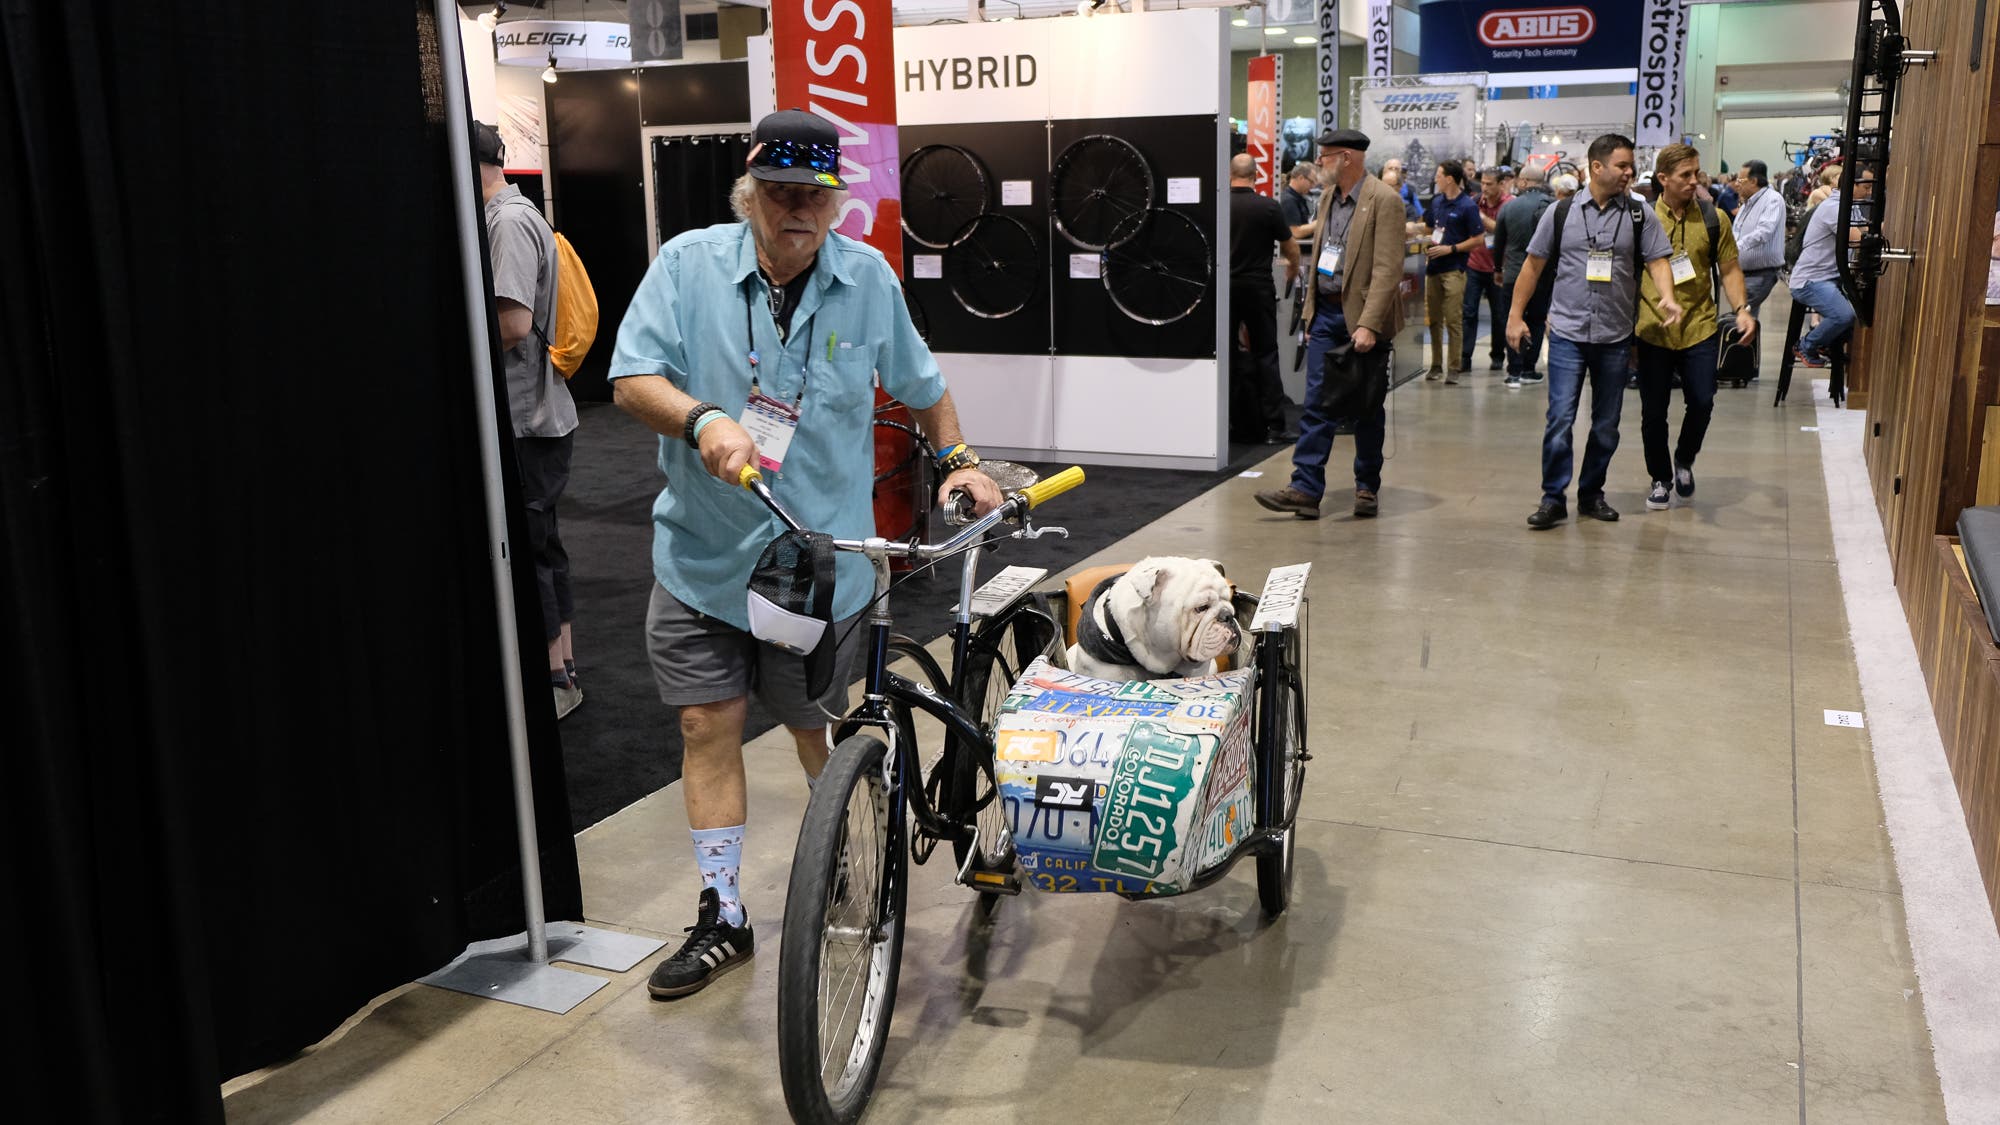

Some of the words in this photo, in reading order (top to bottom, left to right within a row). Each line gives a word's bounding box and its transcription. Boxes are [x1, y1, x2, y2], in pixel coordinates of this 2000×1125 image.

[1493, 15, 1580, 39] ABUS
[1492, 49, 1523, 59] Security
[1524, 48, 1542, 57] Tech
[1543, 48, 1578, 58] Germany
[904, 54, 1038, 93] HYBRID
[1374, 92, 1461, 104] JAMIS
[1381, 101, 1461, 113] BIKES
[1384, 116, 1451, 131] SUPERBIKE.
[1105, 749, 1142, 841] COLORADO
